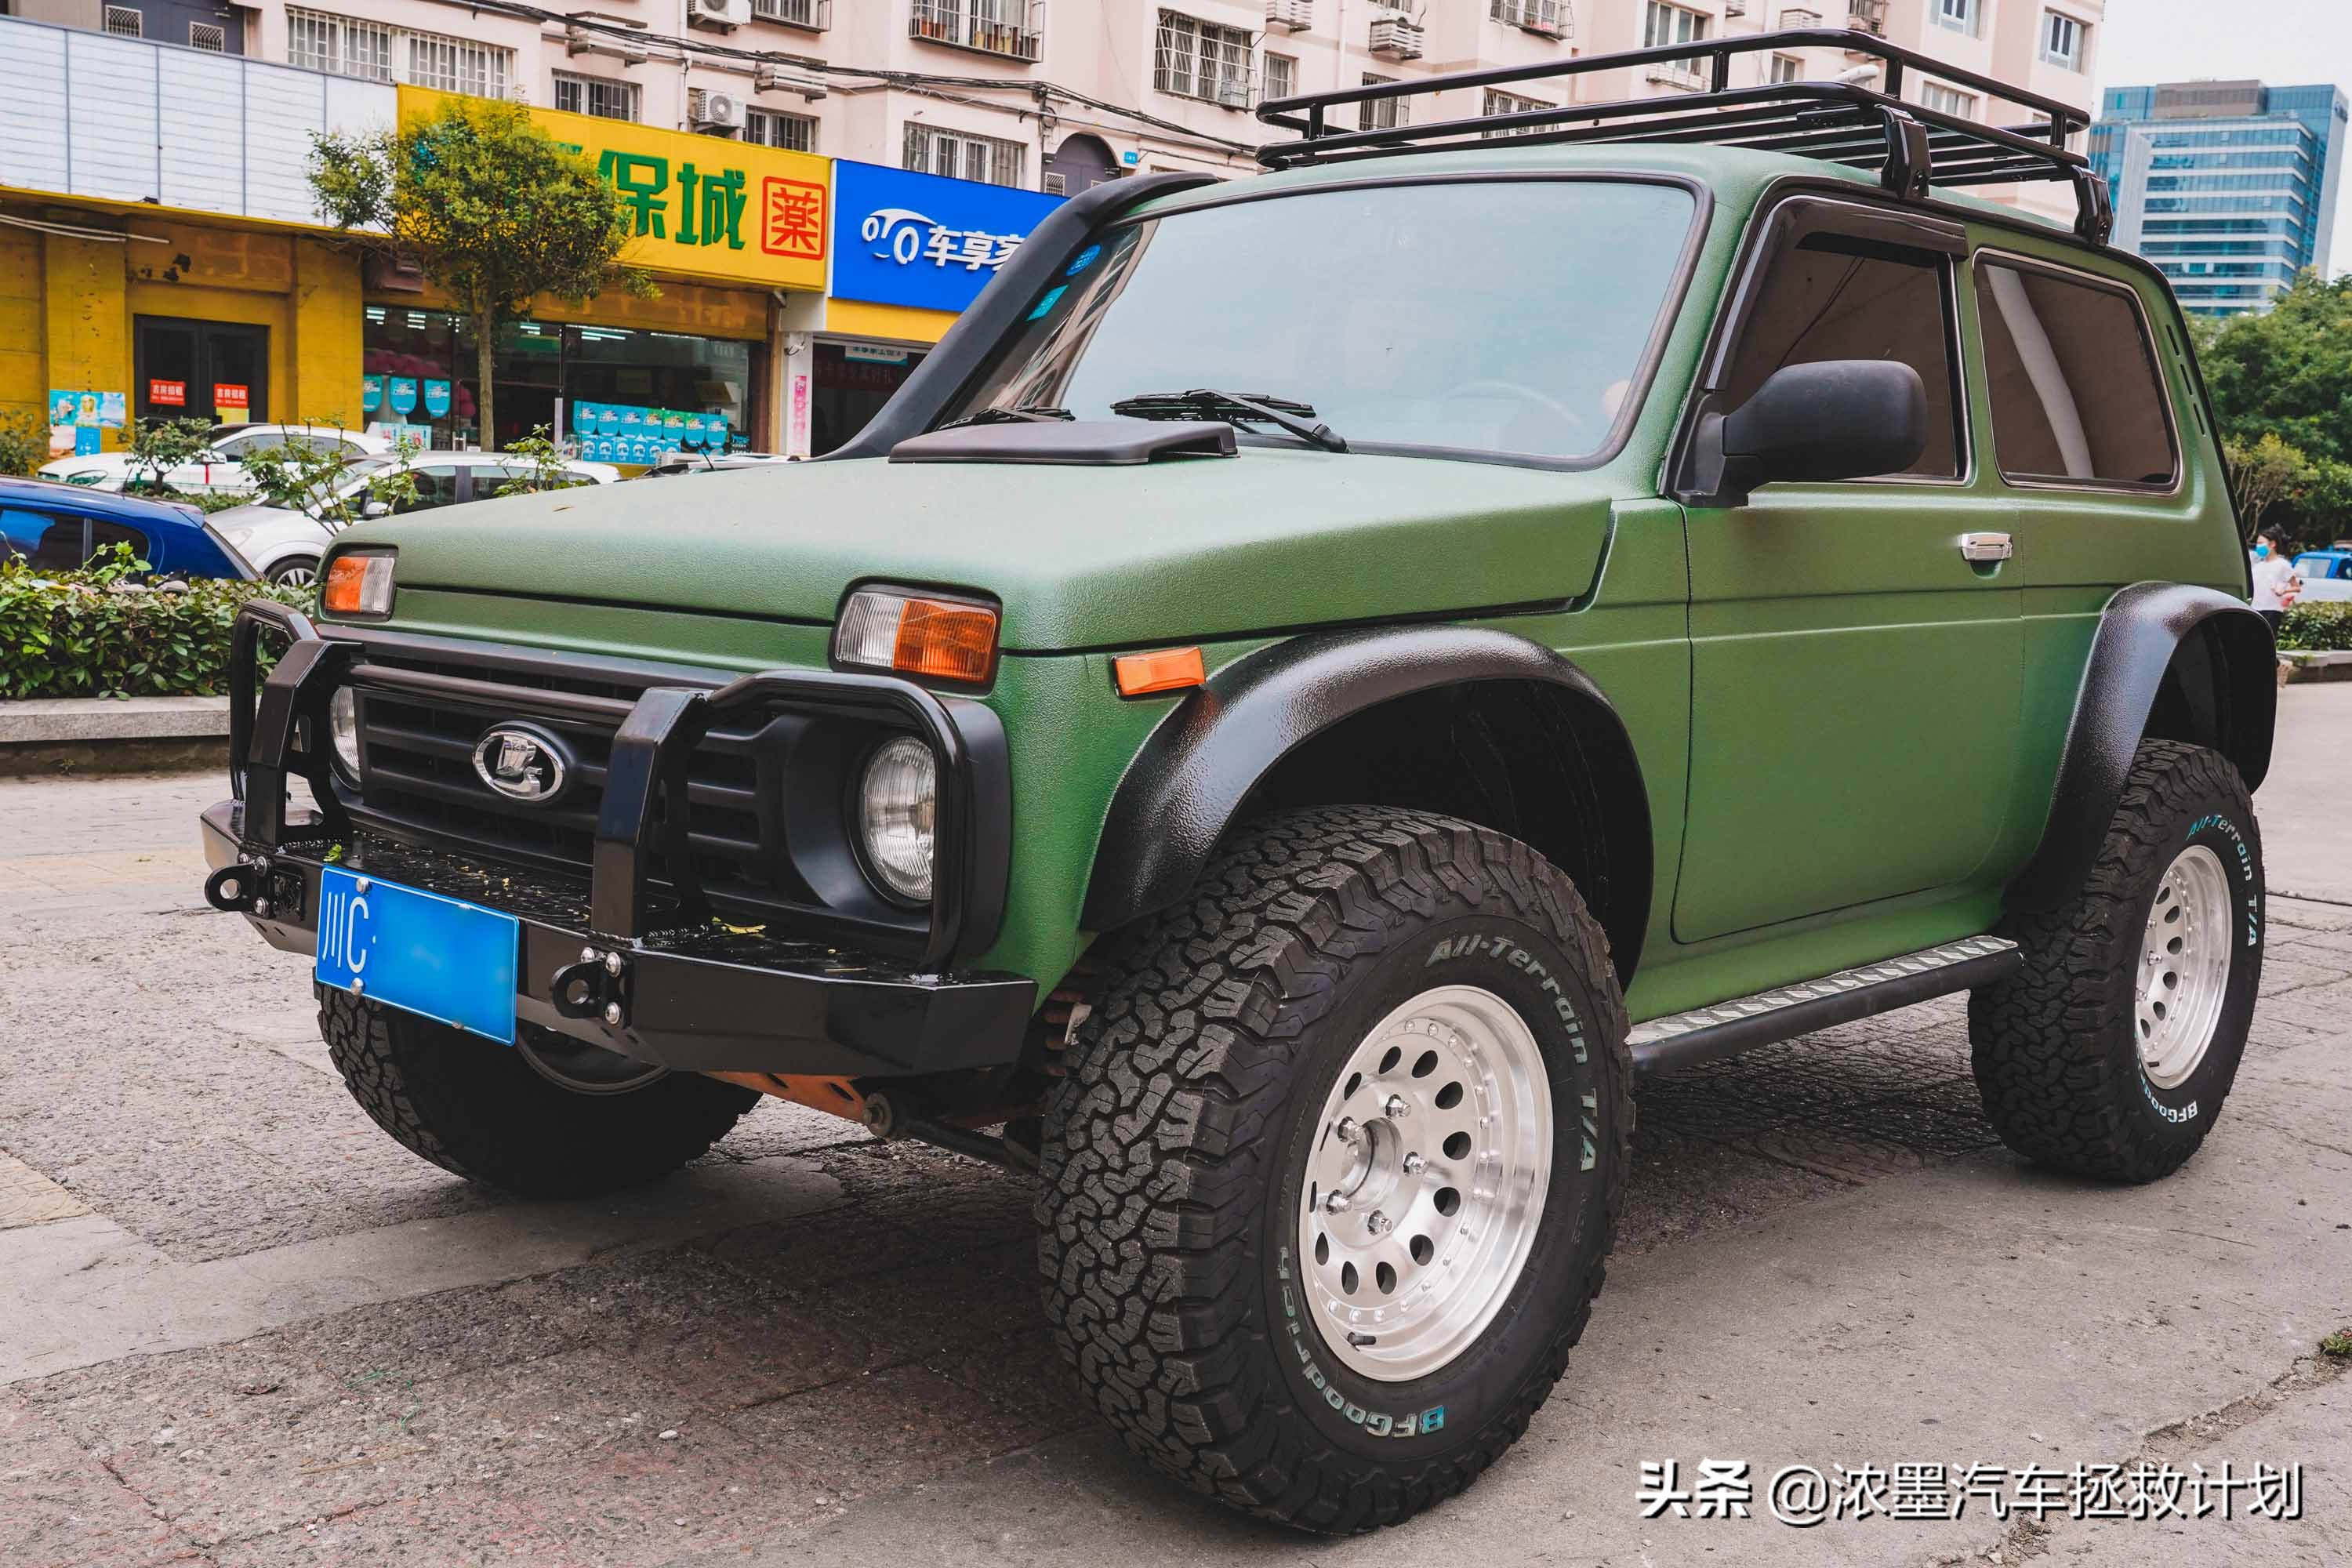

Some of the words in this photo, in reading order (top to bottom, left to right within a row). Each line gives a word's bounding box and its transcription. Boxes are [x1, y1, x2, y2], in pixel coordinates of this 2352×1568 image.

[551, 141, 747, 251] 保城
[2247, 894, 2258, 947] T/A
[1580, 1087, 1599, 1173] T/A
[1277, 1245, 1445, 1439] BFGoodrich
